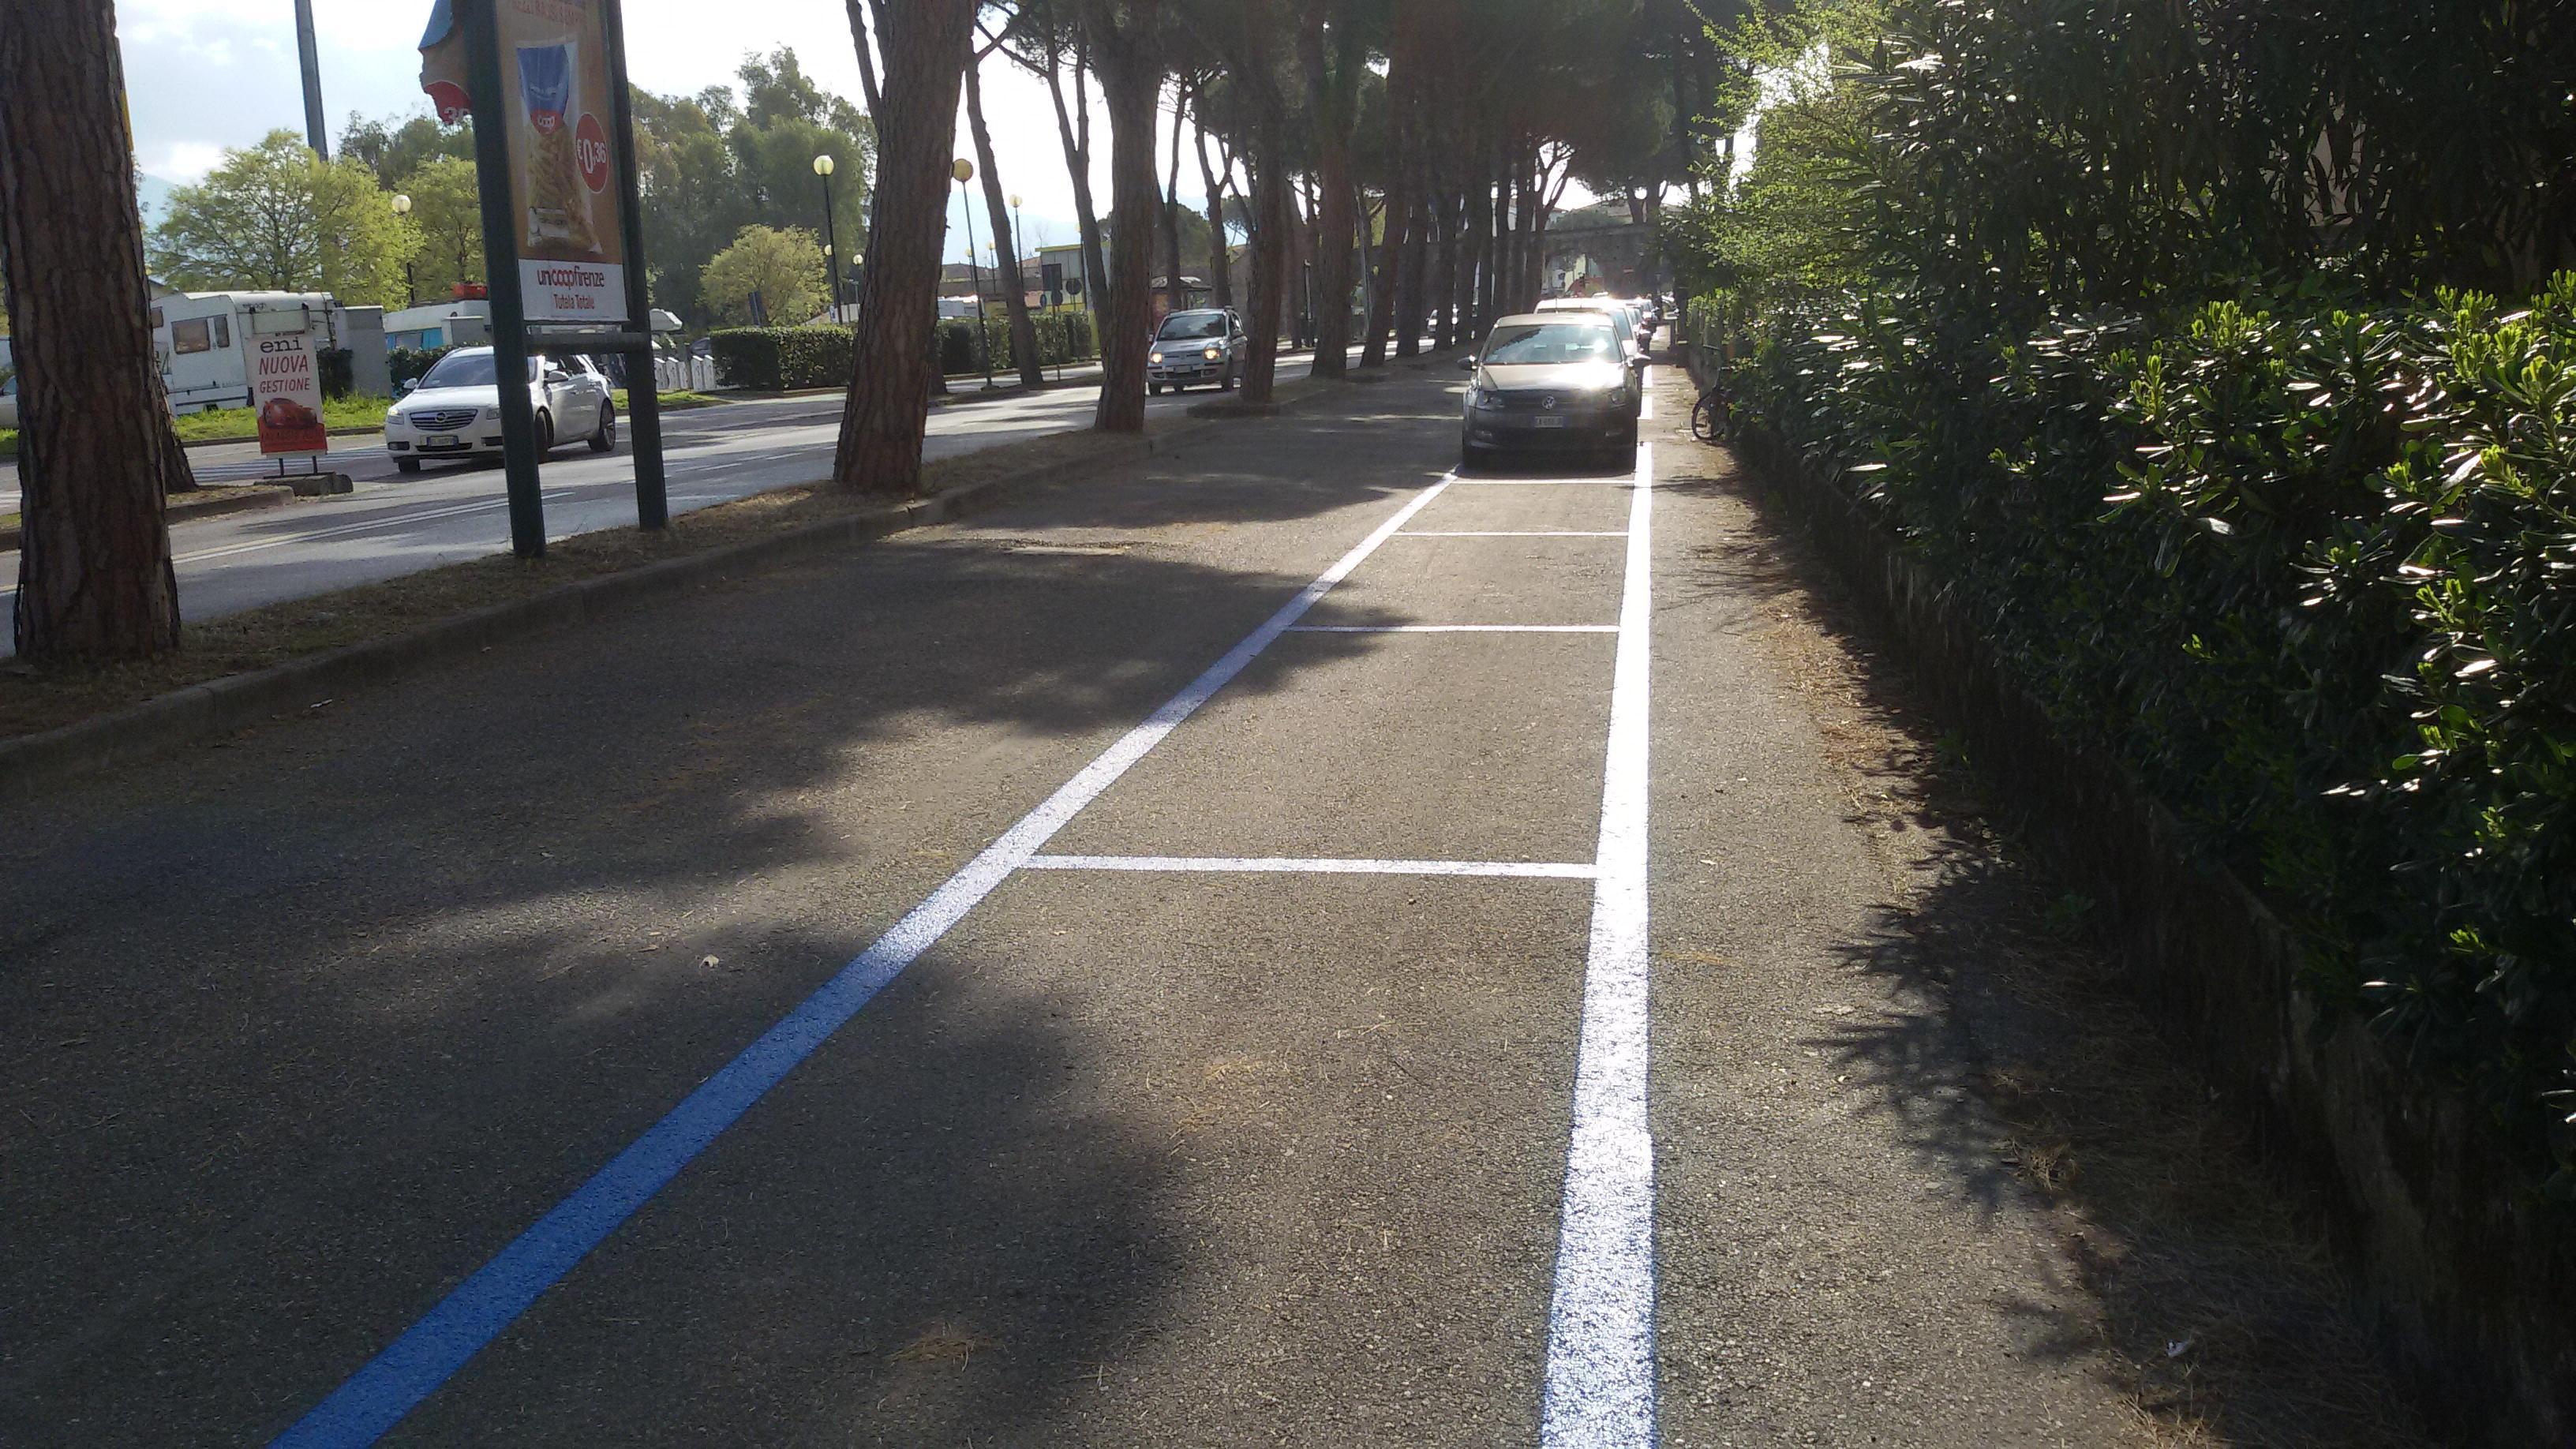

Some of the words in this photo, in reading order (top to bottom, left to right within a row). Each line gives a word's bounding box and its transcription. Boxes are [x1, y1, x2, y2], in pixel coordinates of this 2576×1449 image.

[260, 337, 302, 353] eni
[259, 355, 309, 375] NUOVA
[260, 378, 310, 393] GESTIONE
